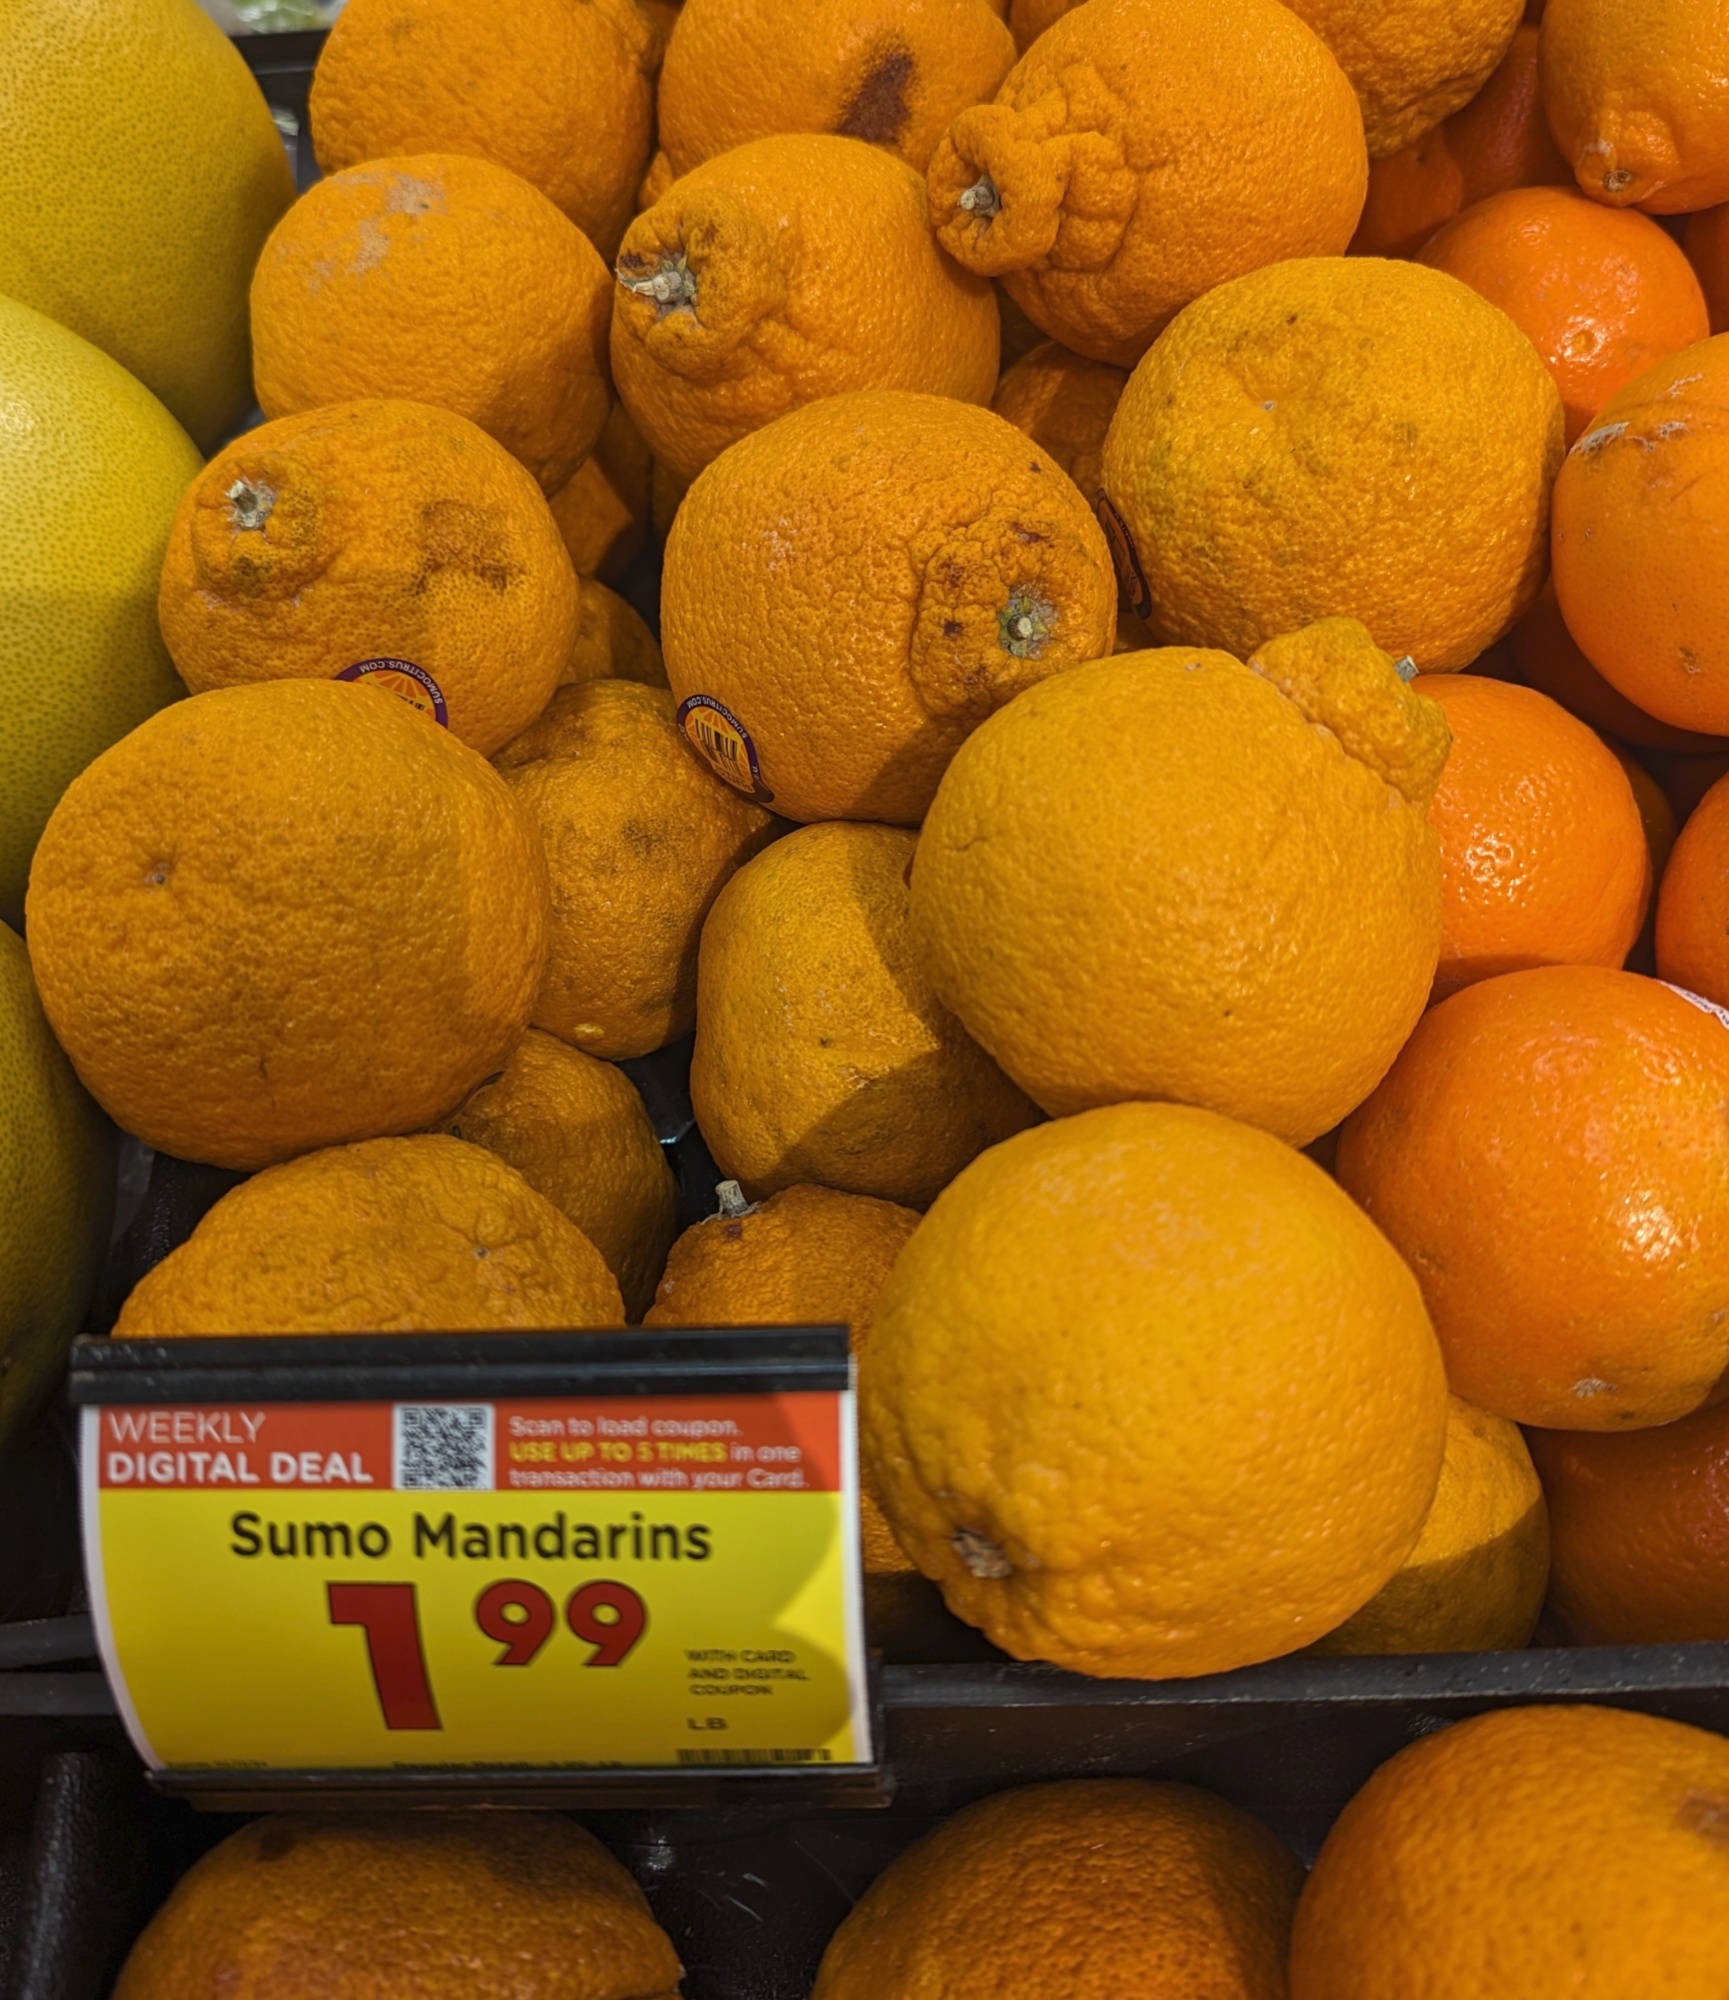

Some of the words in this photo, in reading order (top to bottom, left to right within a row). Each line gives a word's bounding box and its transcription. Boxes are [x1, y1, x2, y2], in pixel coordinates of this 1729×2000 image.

[108, 1411, 267, 1443] WEEKLY
[509, 1415, 565, 1437] Scan
[567, 1417, 595, 1437] to
[597, 1415, 648, 1437] load
[650, 1419, 743, 1441] coupon.
[508, 1442, 557, 1462] USE
[560, 1442, 595, 1462] UP
[598, 1442, 633, 1462] TO
[636, 1442, 654, 1462] 5
[655, 1442, 728, 1462] TIMES
[730, 1442, 755, 1462] in
[756, 1446, 802, 1463] one
[107, 1452, 260, 1483] DIGITAL
[270, 1452, 374, 1484] DEAL
[508, 1468, 635, 1488] transaction
[636, 1468, 689, 1488] with
[690, 1472, 744, 1491] your
[746, 1468, 809, 1488] Card.
[230, 1510, 392, 1558] Sumo
[413, 1509, 713, 1560] Mandarins
[325, 1581, 444, 1731] 1
[473, 1577, 651, 1667] 99
[687, 1649, 737, 1662] WITH
[739, 1650, 796, 1663] CARD
[687, 1667, 730, 1680] AND
[732, 1668, 811, 1681] DIGITAL
[688, 1684, 775, 1696] COUPON
[687, 1716, 728, 1731] LB
